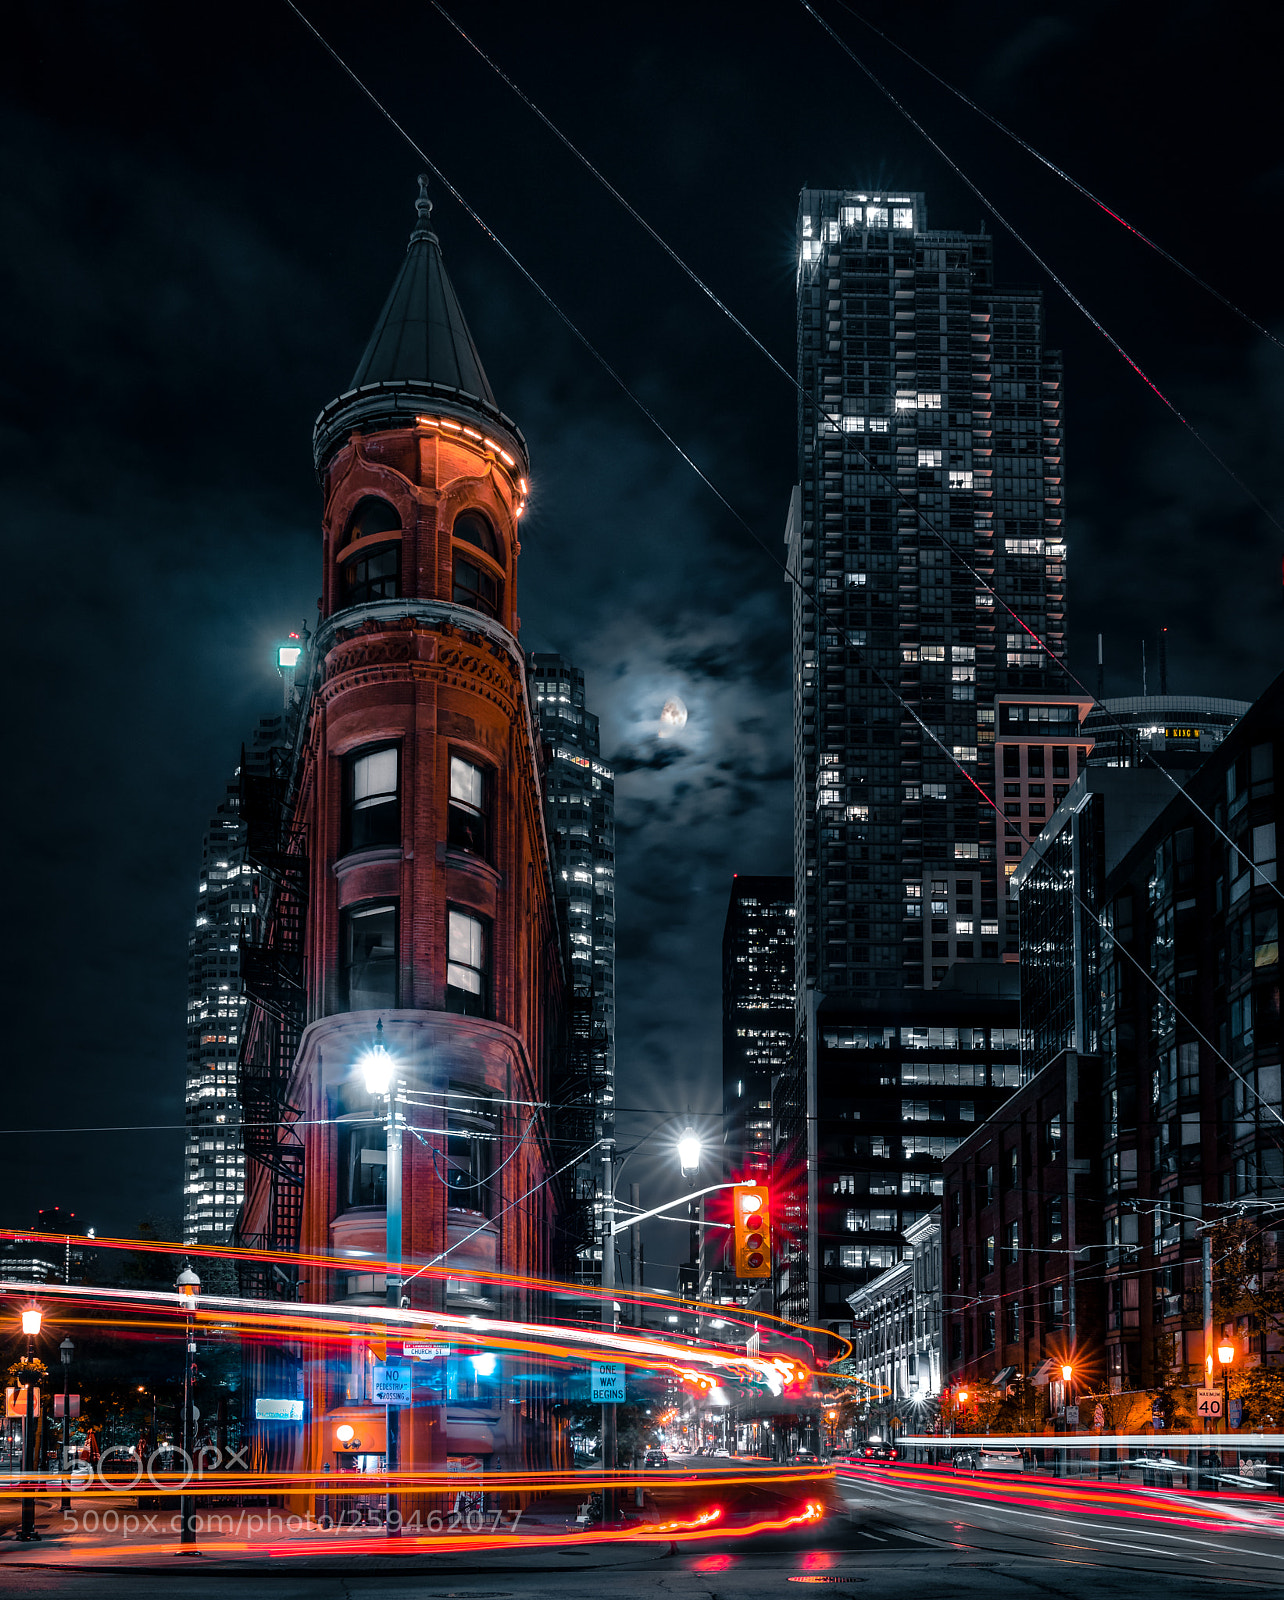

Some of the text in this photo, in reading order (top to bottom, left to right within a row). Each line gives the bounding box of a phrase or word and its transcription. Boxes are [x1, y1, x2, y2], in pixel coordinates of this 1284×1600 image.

[1173, 729, 1191, 737] KING
[599, 1365, 617, 1374] ONE
[385, 1370, 399, 1381] NO
[599, 1377, 617, 1386] WAY
[376, 1392, 405, 1400] ROSSING
[593, 1389, 624, 1399] BEGINS
[1199, 1400, 1220, 1413] 40
